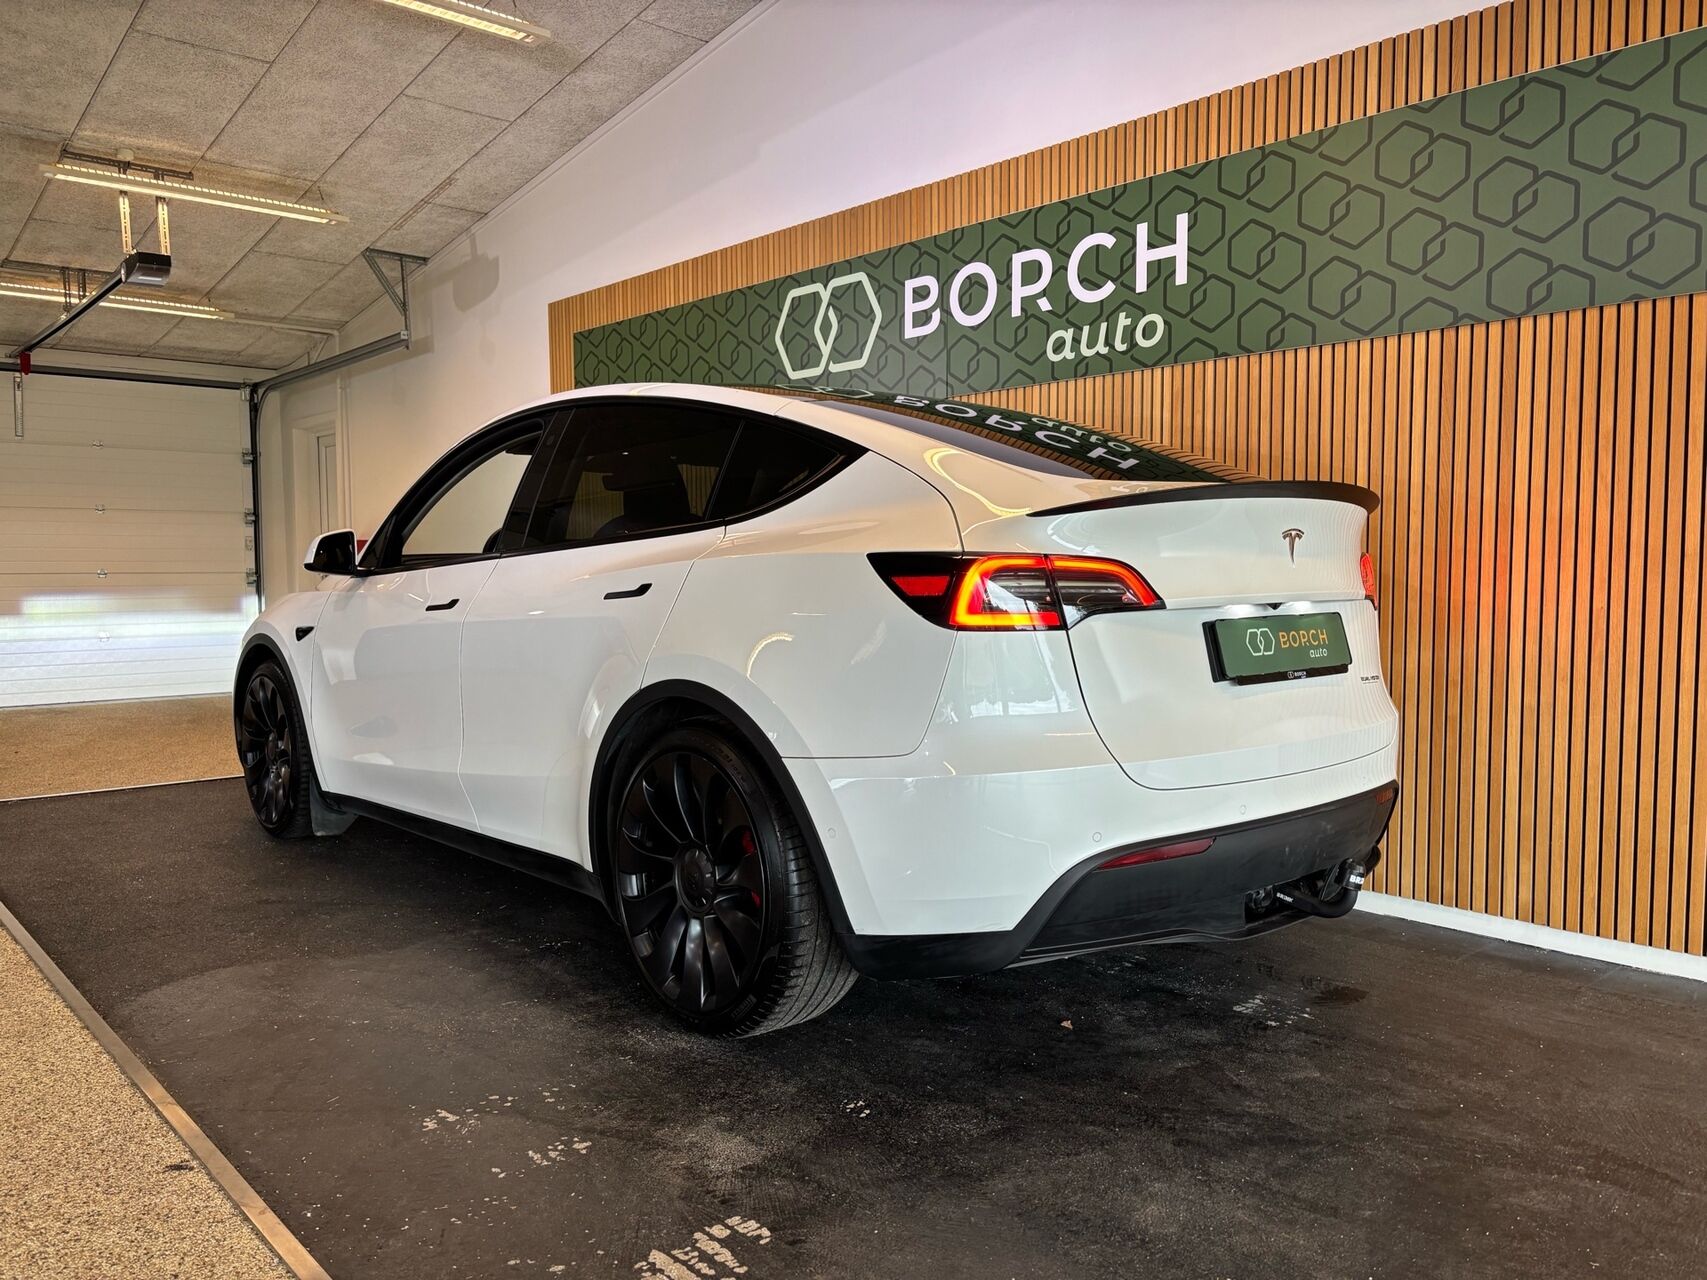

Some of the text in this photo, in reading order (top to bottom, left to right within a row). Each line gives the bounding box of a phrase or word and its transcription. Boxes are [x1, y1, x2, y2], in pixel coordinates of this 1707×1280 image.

[903, 212, 1188, 339] BORCH
[1046, 311, 1165, 362] auto
[1278, 628, 1329, 649] BORCH
[1309, 648, 1328, 659] auto
